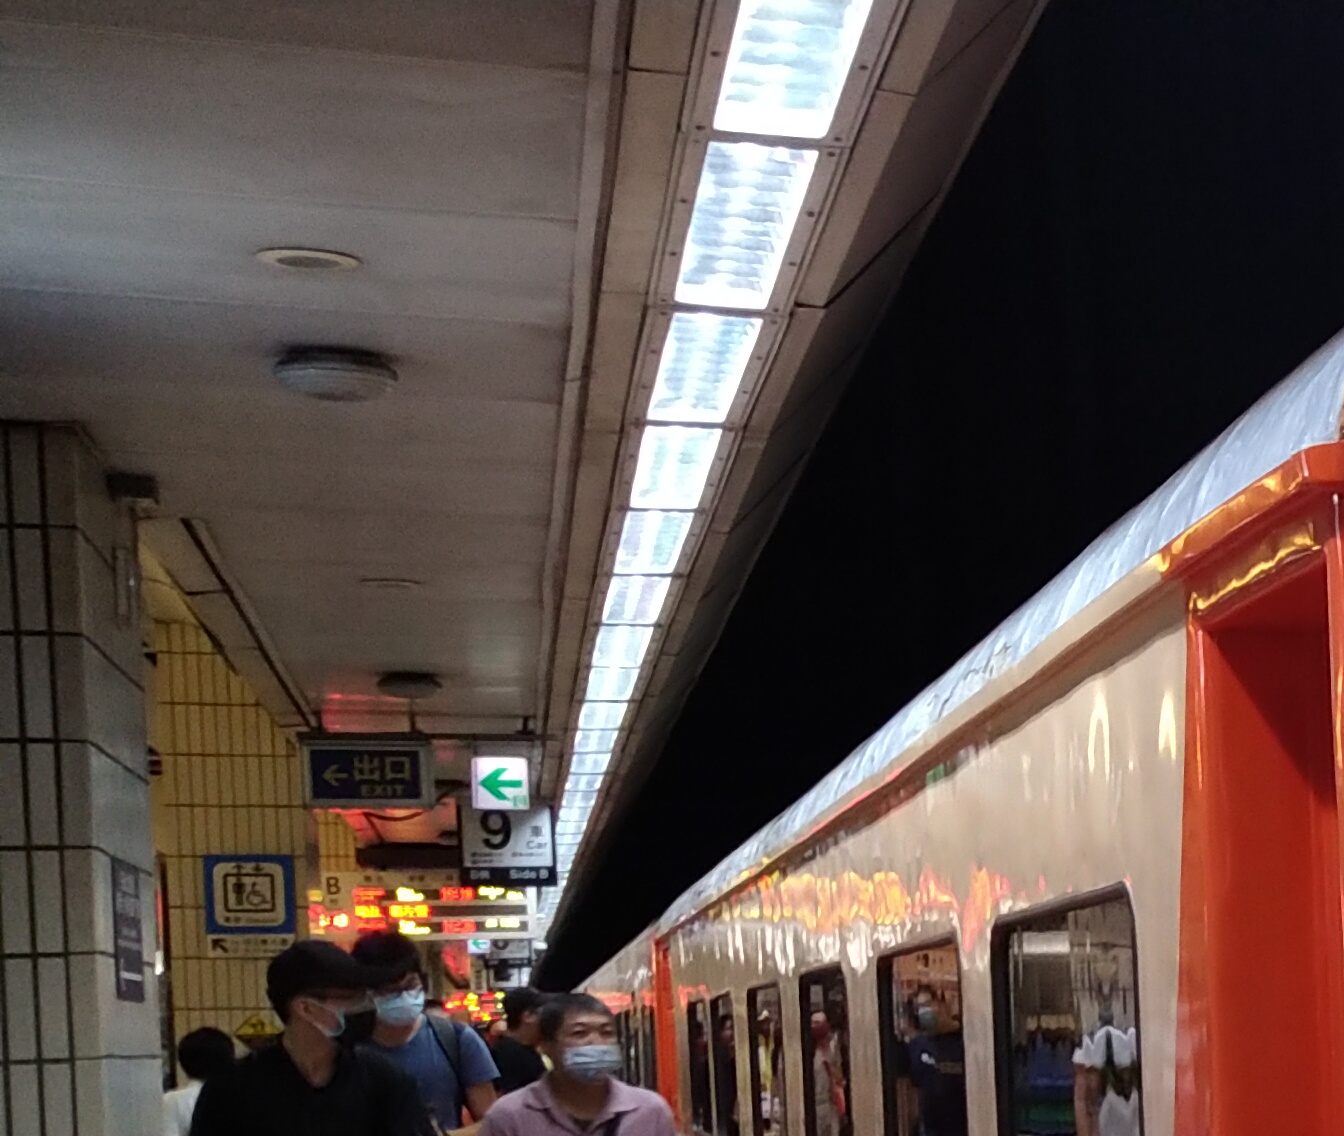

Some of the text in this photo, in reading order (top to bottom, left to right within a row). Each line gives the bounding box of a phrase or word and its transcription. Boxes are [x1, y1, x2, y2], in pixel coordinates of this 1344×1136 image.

[353, 754, 411, 781] 出口
[360, 785, 405, 797] EXIT
[480, 809, 512, 850] 9
[325, 876, 341, 895] B
